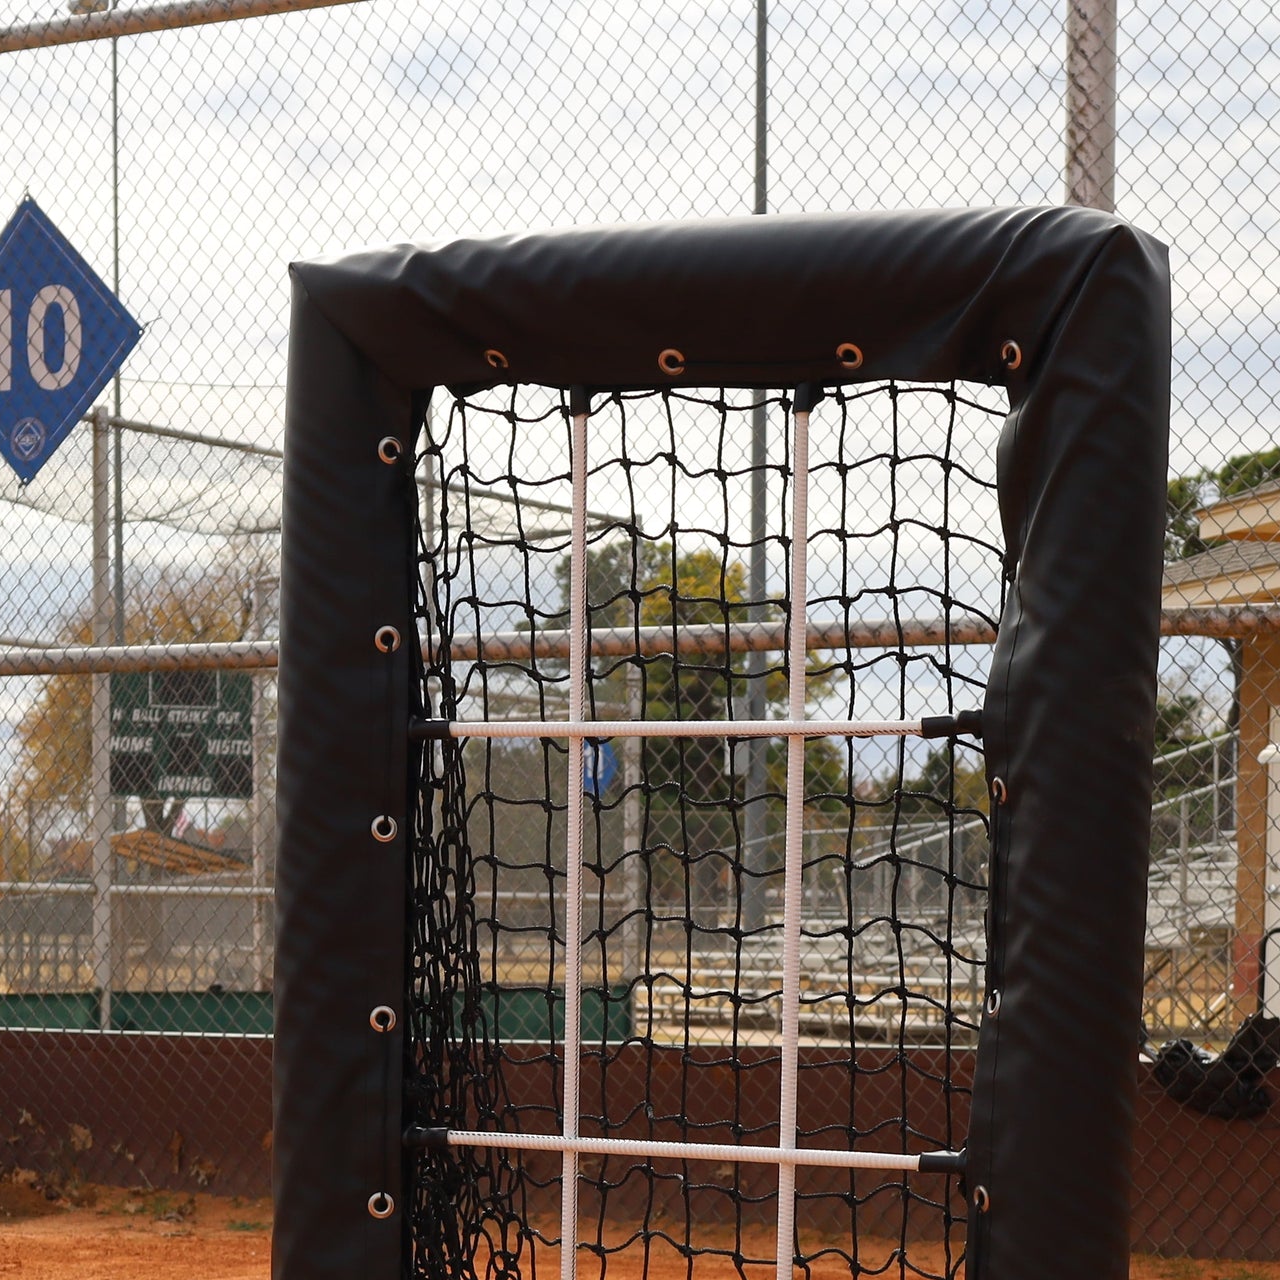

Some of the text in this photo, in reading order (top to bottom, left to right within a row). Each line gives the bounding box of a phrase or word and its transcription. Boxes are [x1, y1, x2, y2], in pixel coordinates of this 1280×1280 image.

[132, 708, 161, 723] BALL
[167, 710, 210, 724] STRIKE
[217, 711, 241, 725] OUT
[109, 736, 252, 756] HOME VISITO
[158, 775, 213, 793] INNING
